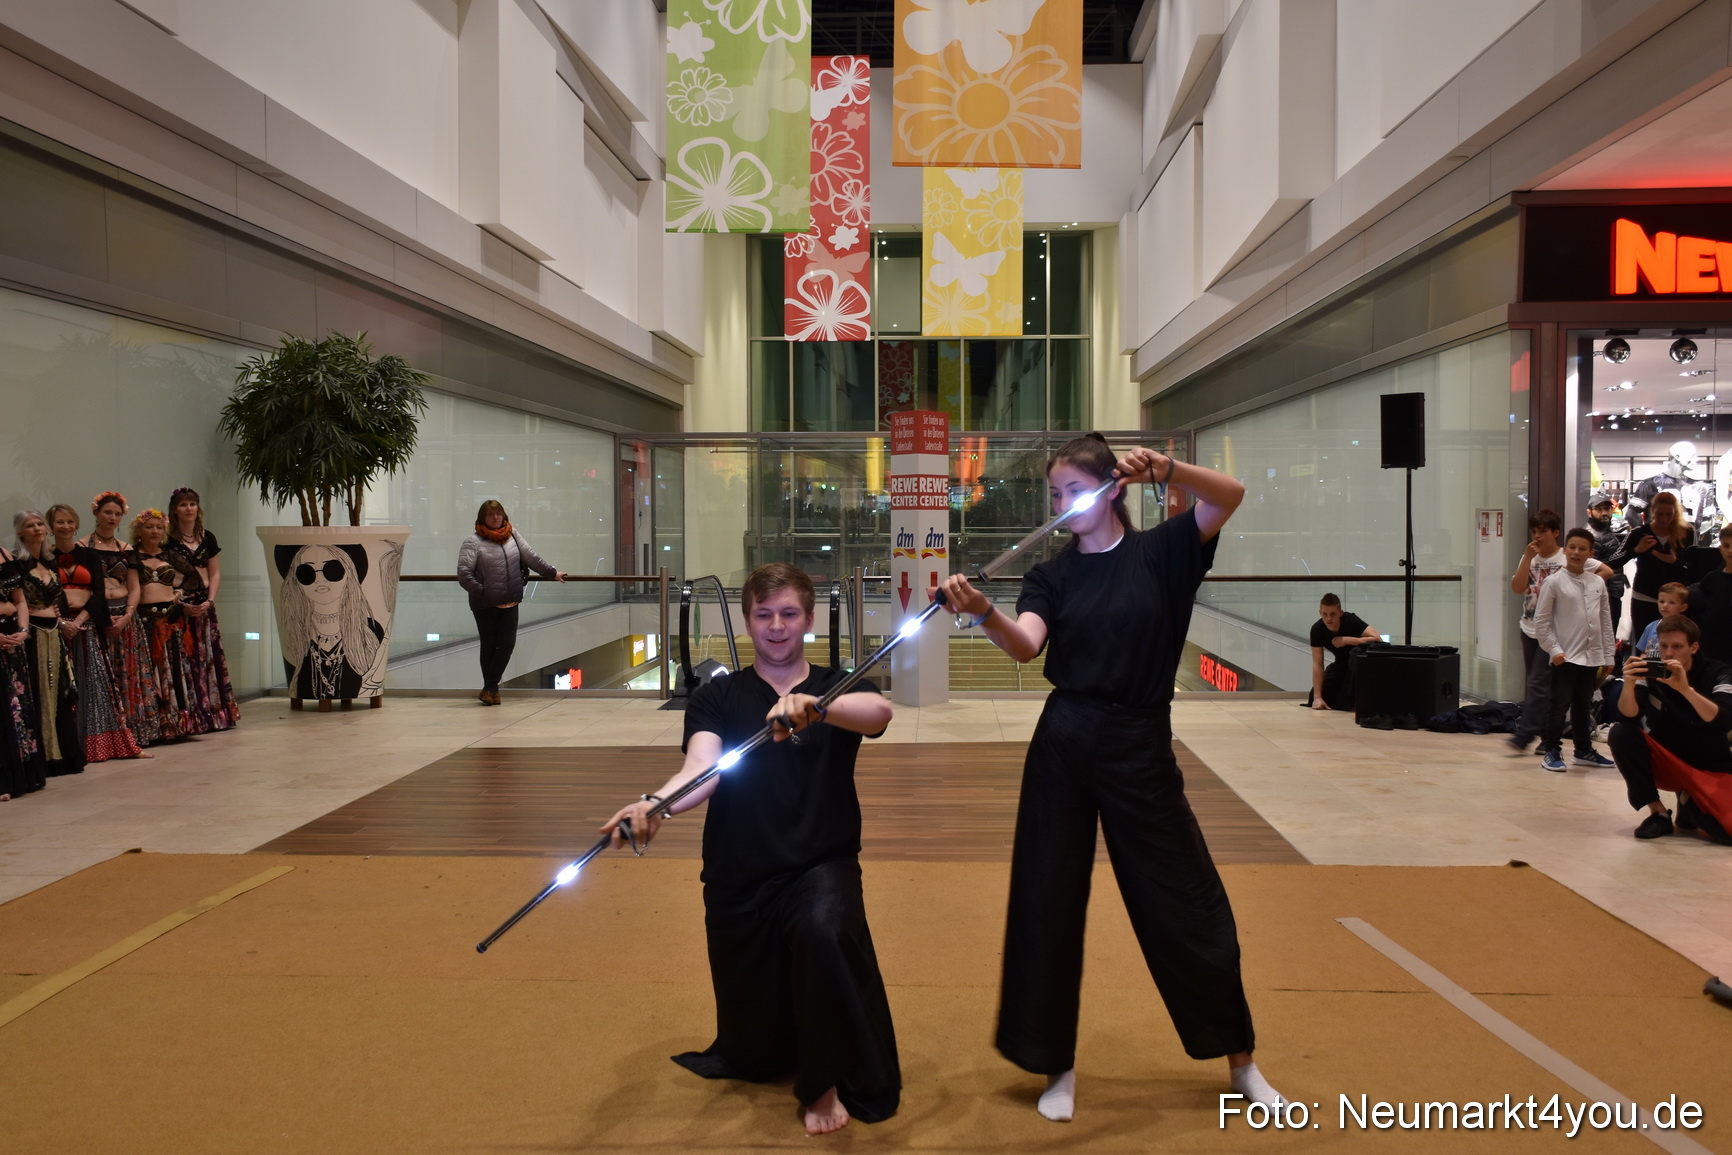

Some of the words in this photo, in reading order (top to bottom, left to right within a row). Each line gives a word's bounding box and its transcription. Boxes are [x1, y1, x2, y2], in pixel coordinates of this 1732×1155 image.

[1613, 218, 1732, 294] NE
[891, 477, 918, 493] REWE
[920, 477, 948, 493] REWE
[892, 495, 918, 507] CENTER
[920, 495, 948, 507] CENTER
[897, 527, 914, 547] dm
[926, 527, 944, 547] dm
